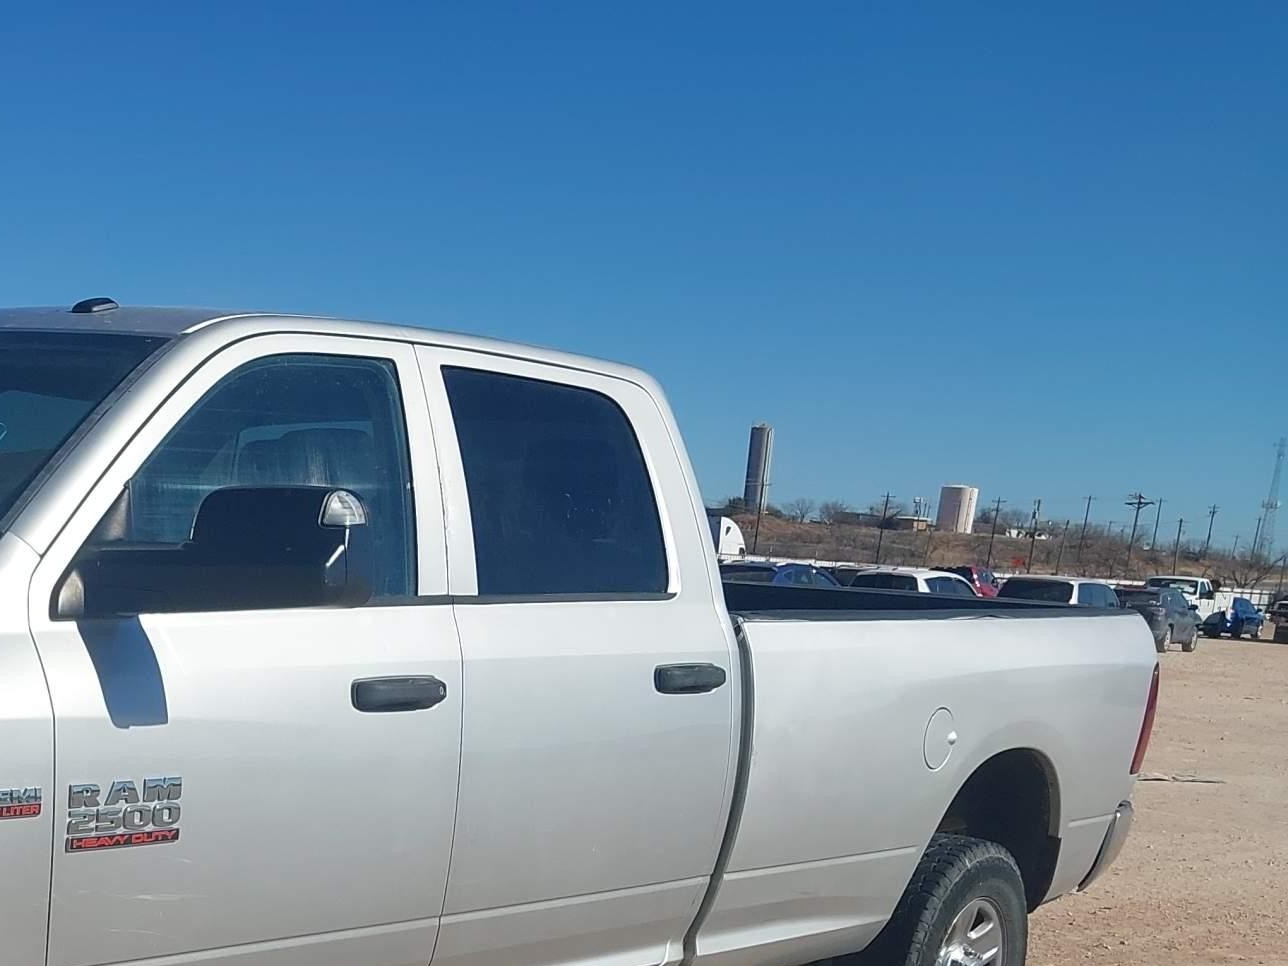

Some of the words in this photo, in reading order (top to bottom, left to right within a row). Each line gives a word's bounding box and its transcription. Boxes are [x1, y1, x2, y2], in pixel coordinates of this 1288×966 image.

[68, 776, 183, 809] RAM
[2, 804, 40, 816] LITER
[66, 802, 181, 836] 2500
[72, 834, 129, 849] HEAVY
[132, 830, 177, 844] DUTY
